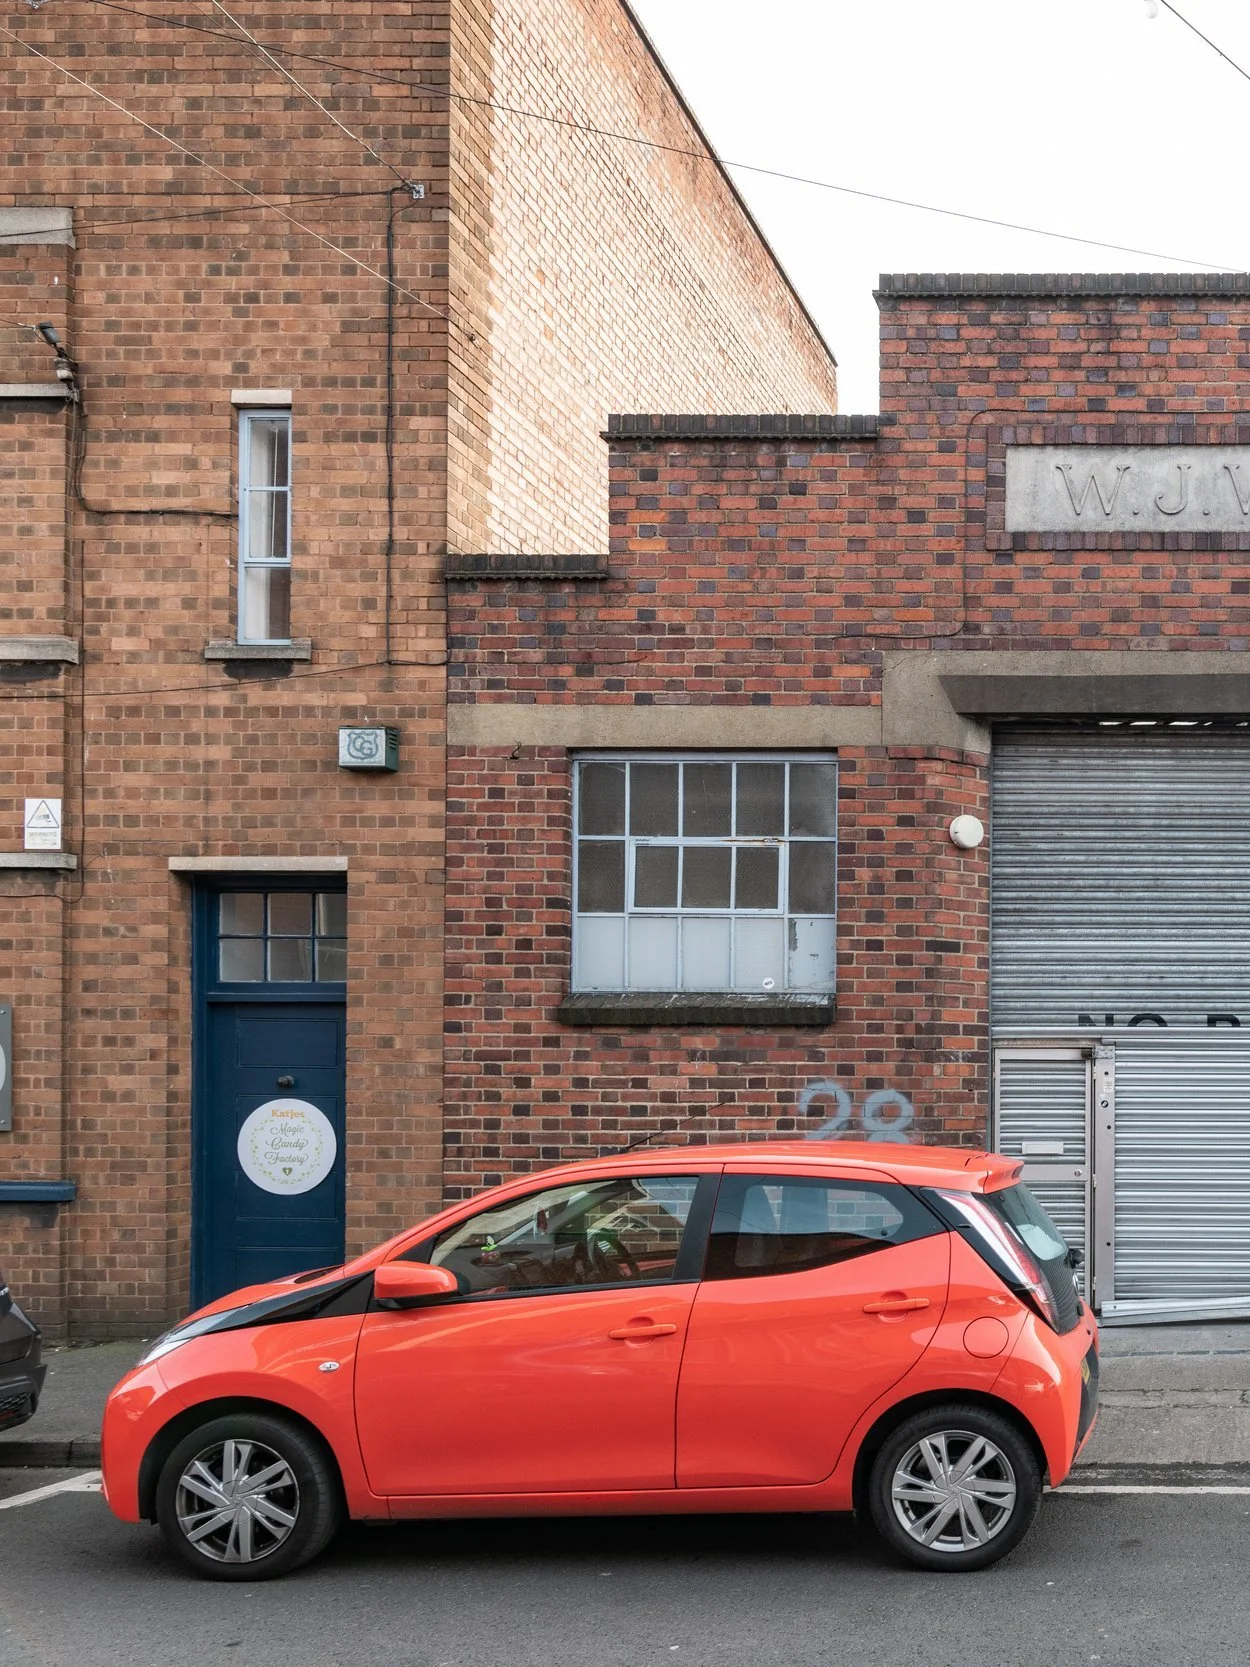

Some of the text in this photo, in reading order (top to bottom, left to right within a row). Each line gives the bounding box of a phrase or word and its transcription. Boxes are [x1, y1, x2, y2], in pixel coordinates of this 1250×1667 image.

[271, 1109, 305, 1119] Katjes
[270, 1122, 304, 1137] Magic
[265, 1137, 309, 1151] Candy
[264, 1151, 309, 1165] Factory
